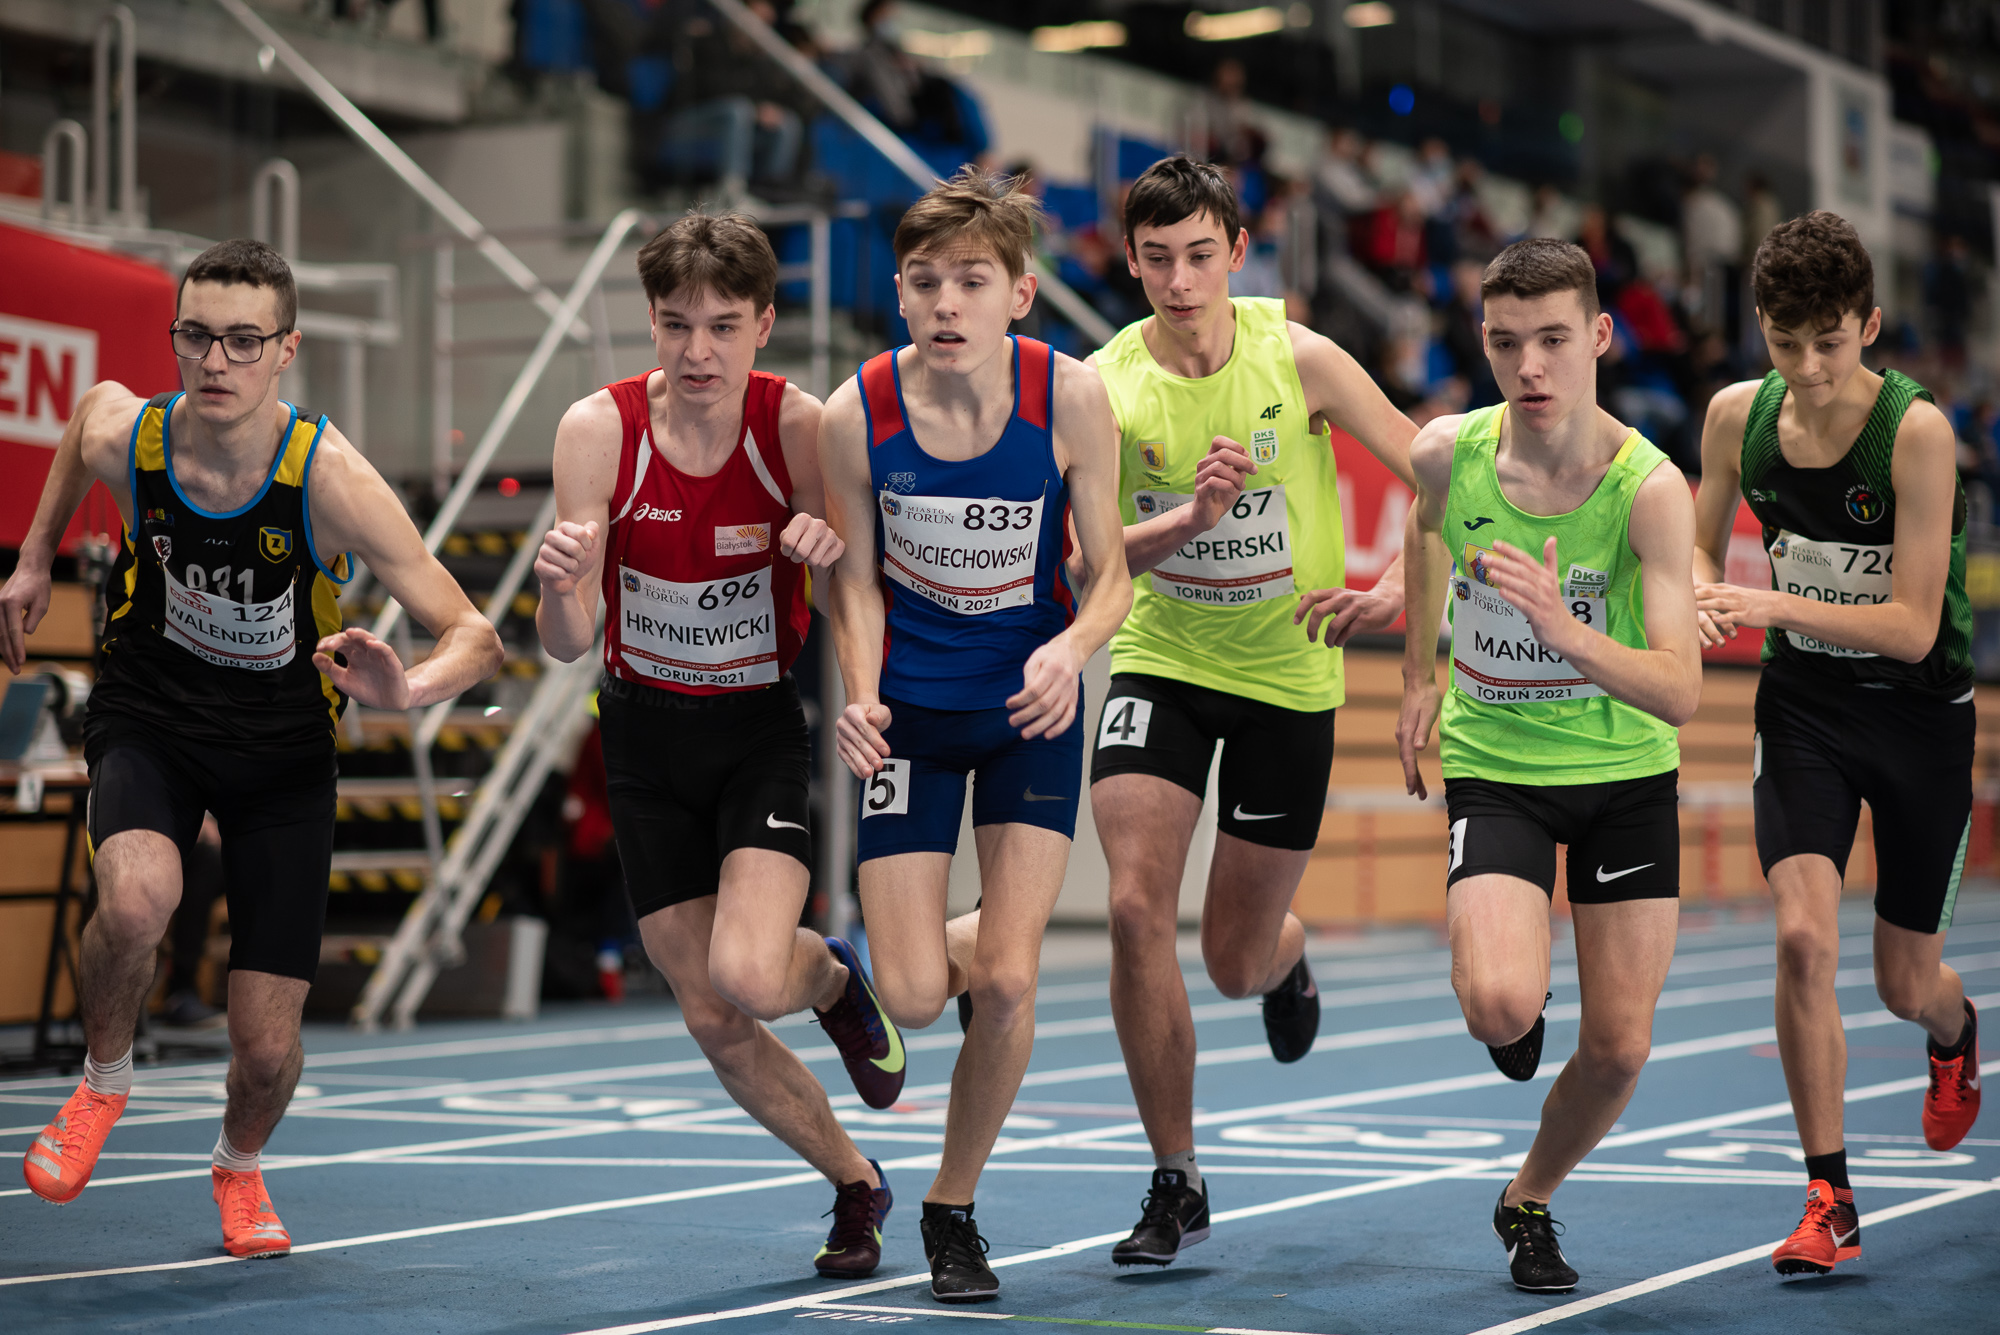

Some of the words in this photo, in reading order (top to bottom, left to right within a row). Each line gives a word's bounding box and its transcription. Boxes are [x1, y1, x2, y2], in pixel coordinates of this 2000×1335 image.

[1254, 430, 1275, 439] DKS
[907, 505, 945, 515] MIASTO
[1231, 489, 1273, 520] 67
[648, 507, 682, 522] asics
[904, 511, 955, 525] TORUŃ
[963, 503, 1034, 532] 833
[271, 538, 281, 549] Z
[716, 540, 753, 551] Białystok
[889, 526, 1034, 570] WOJCIECHOWSKI
[1176, 531, 1285, 561] CPERSKI
[1792, 545, 1823, 557] MIASTO
[1790, 550, 1832, 568] TORUŃ
[1571, 569, 1606, 582] DKS
[644, 587, 689, 606] TORUŃ
[645, 583, 679, 595] MIASTO
[697, 574, 760, 611] 696
[909, 579, 959, 610] TORUŃ
[964, 596, 1000, 612] 2021
[928, 581, 977, 595] MISTRZOSTWA
[1175, 586, 1224, 602] TORUŃ
[1228, 587, 1263, 603] 2021
[1474, 589, 1504, 606] MIASTO
[1788, 582, 1892, 605] BORECK
[171, 589, 211, 615] ORLEN
[232, 591, 292, 622] 124
[1472, 595, 1514, 618] TORUŃ
[626, 609, 770, 647] HRYNIEWICKI
[191, 643, 241, 667] TORUŃ
[246, 659, 282, 670] 2021
[1475, 630, 1563, 664] MAŃK
[644, 653, 671, 664] HALOWE
[671, 660, 719, 670] MISTRZOSTWA
[720, 660, 743, 670] POLSKI
[651, 664, 704, 683] TORUŃ
[709, 671, 745, 685] 2021
[1495, 679, 1545, 687] MISTRZOSTWA
[1476, 684, 1530, 701] TORUŃ
[1535, 688, 1572, 700] 2021
[1106, 701, 1137, 741] 4
[868, 764, 896, 811] 5
